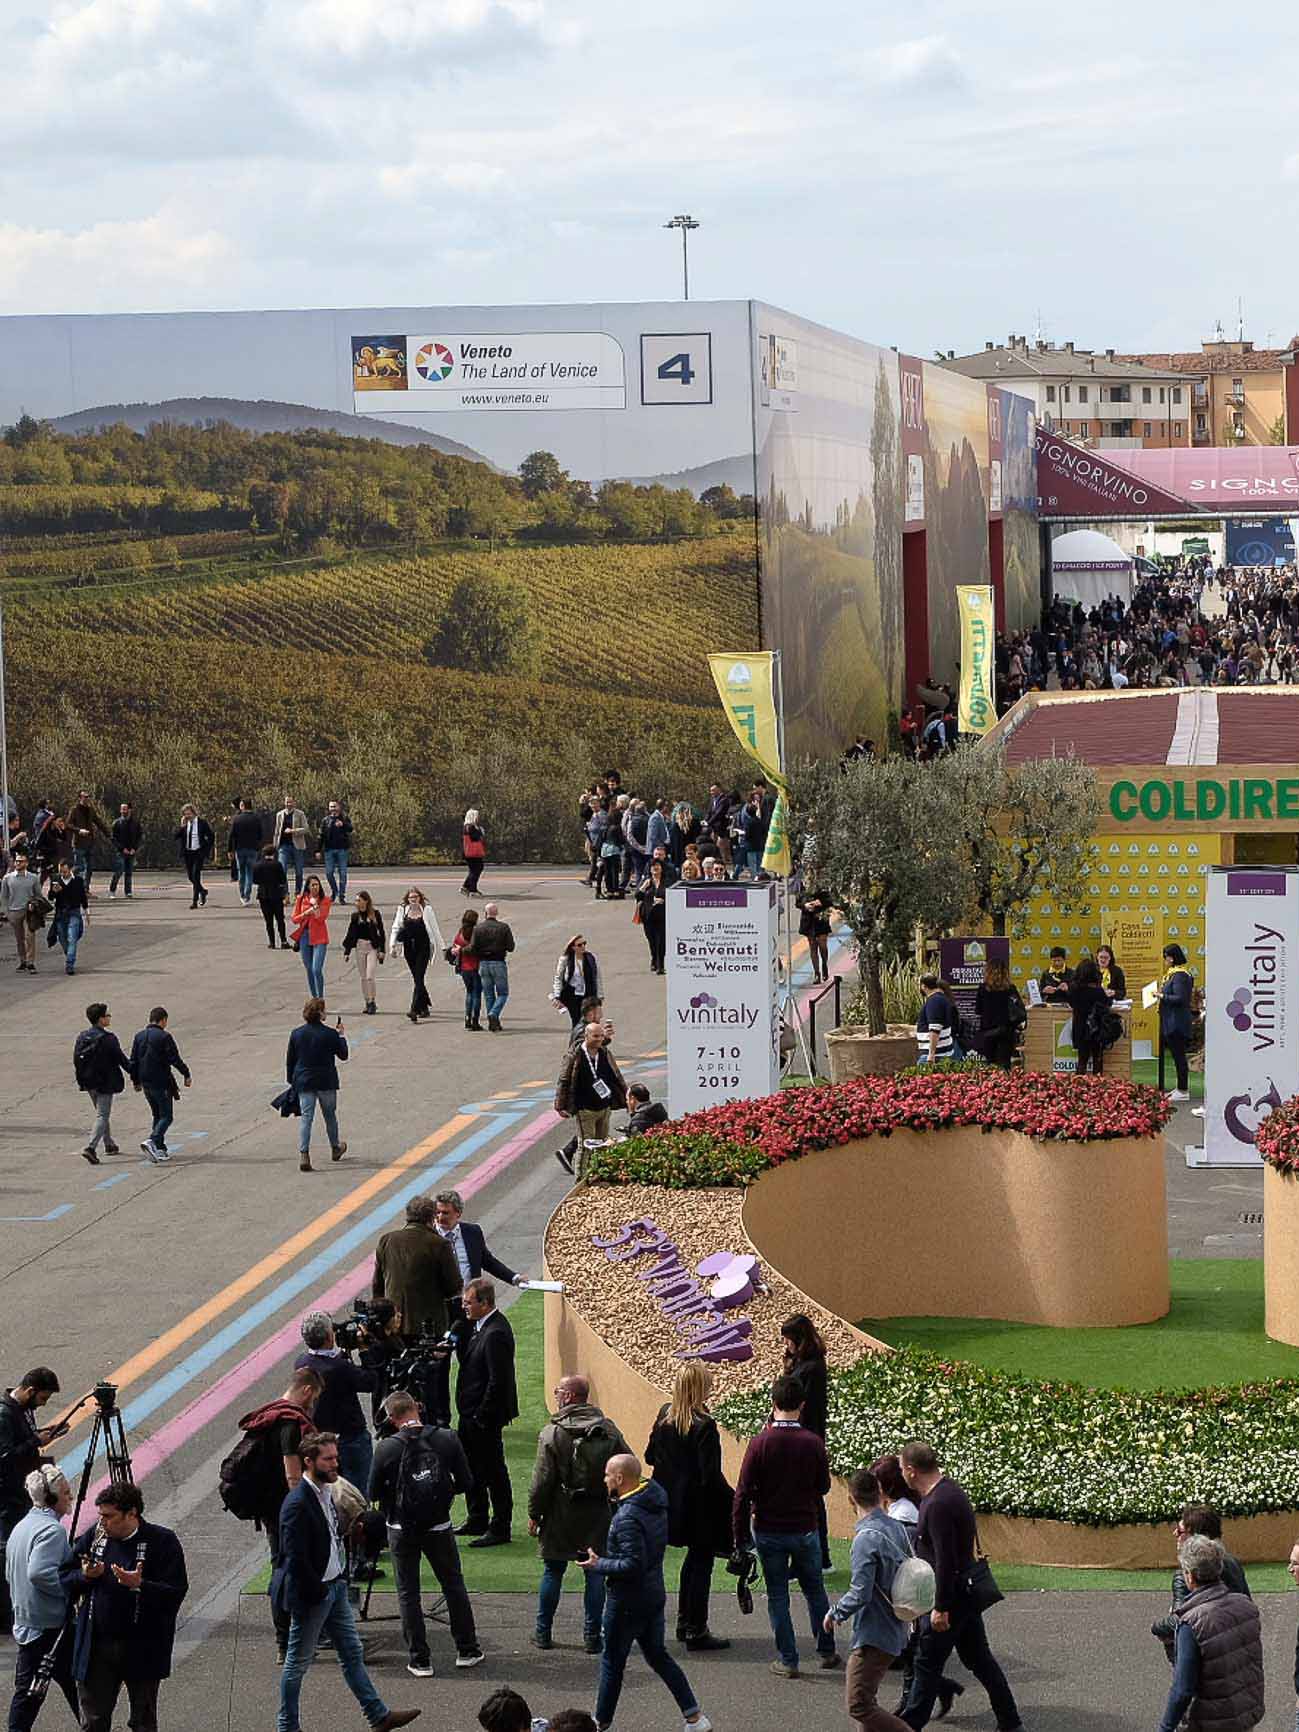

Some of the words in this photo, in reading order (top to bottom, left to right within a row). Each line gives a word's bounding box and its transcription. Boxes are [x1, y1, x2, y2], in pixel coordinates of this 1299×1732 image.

[460, 344, 513, 359] Veneto
[461, 363, 487, 380] The
[490, 362, 527, 379] Land
[530, 362, 547, 379] of
[550, 362, 599, 379] Venice
[656, 353, 696, 385] 4
[461, 393, 549, 405] www.veneto.eu
[1035, 436, 1148, 505] SIGNORVINO
[676, 942, 759, 956] Benvenuti
[704, 962, 759, 973] Welcome
[1244, 923, 1285, 1051] vinitaly
[677, 1003, 760, 1029] vinitaly
[697, 1047, 741, 1059] 7-10
[696, 1063, 741, 1072] APRIL
[699, 1076, 740, 1088] 2019
[634, 1253, 755, 1363] vinitaly
